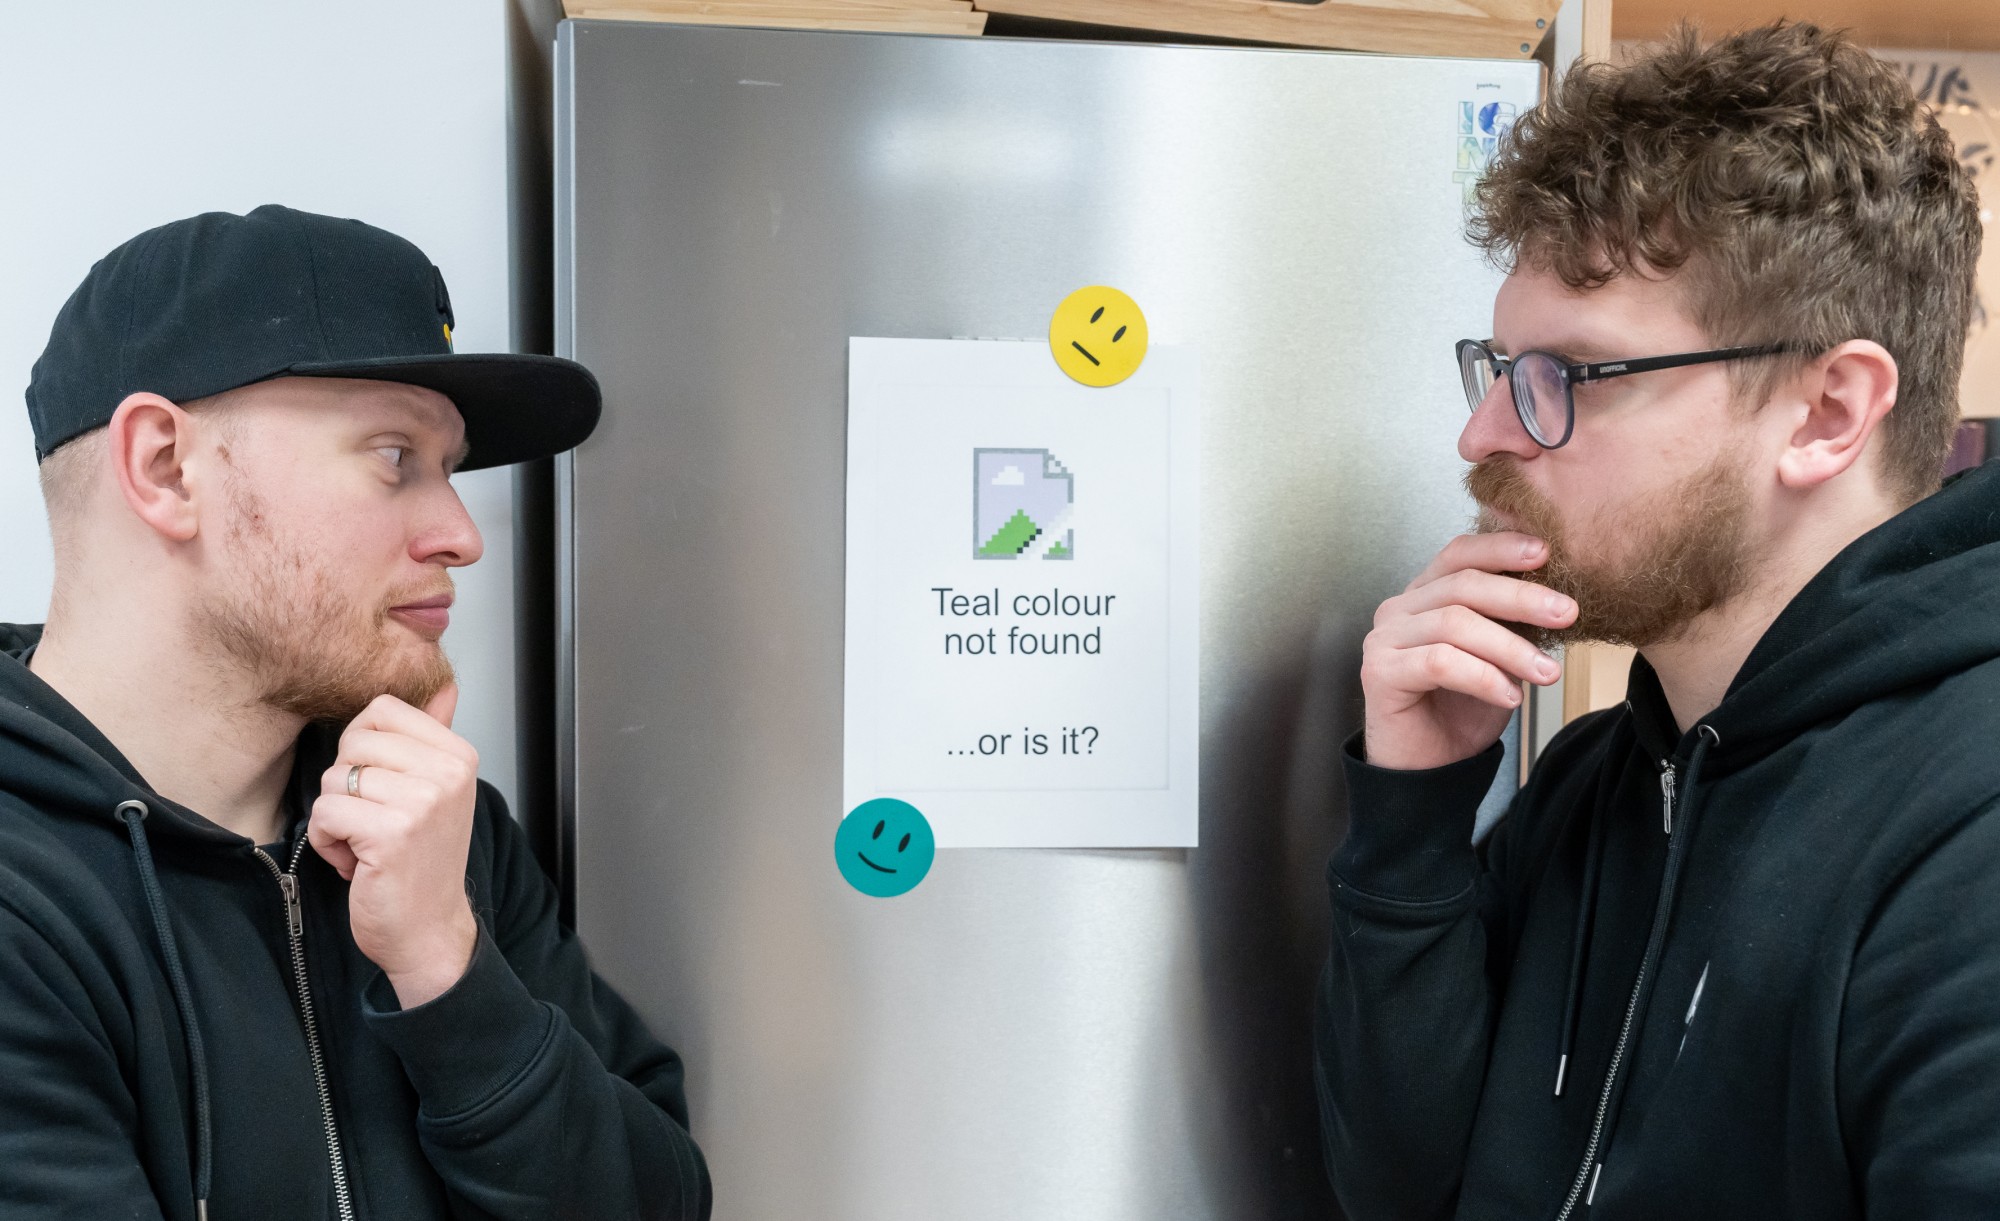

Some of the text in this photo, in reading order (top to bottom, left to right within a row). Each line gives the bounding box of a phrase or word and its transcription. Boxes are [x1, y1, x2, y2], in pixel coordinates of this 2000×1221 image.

[931, 587, 1116, 617] Teal colour
[945, 625, 1101, 655] not found
[948, 725, 1099, 756] ...or is it?
